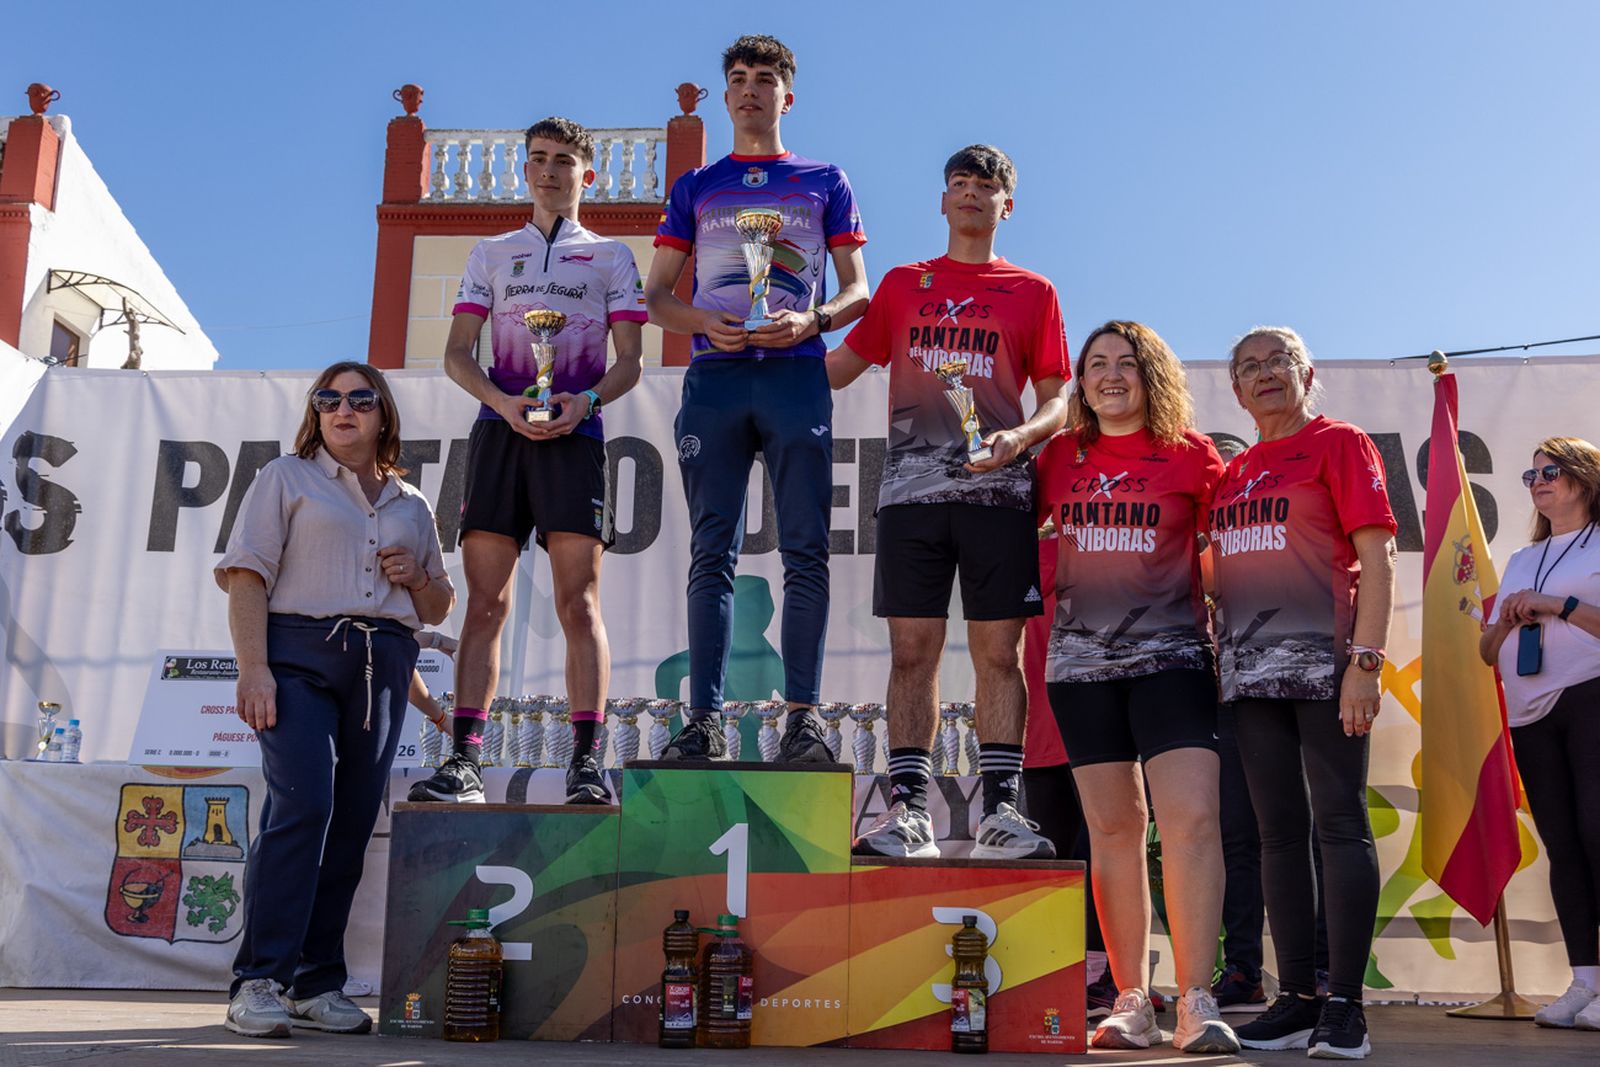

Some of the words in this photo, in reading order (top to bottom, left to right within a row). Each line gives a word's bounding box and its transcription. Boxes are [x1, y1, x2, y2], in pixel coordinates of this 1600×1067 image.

[918, 302, 993, 319] CROSS
[910, 325, 1000, 356] PANTANO
[910, 346, 922, 358] DEL
[1071, 477, 1149, 493] CROSS
[1061, 502, 1160, 527] PANTANO
[1208, 496, 1290, 532] PANTANO
[1062, 523, 1076, 535] DEL
[1076, 521, 1157, 553] VÍBORAS
[1220, 524, 1287, 557] VÍBORAS
[186, 659, 208, 669] Los
[201, 705, 225, 715] CROSS
[212, 731, 246, 743] PÁGUESE
[709, 822, 749, 918] 1
[475, 865, 534, 961] 2
[931, 906, 1003, 1003] 3
[760, 997, 842, 1009] DEPORTES
